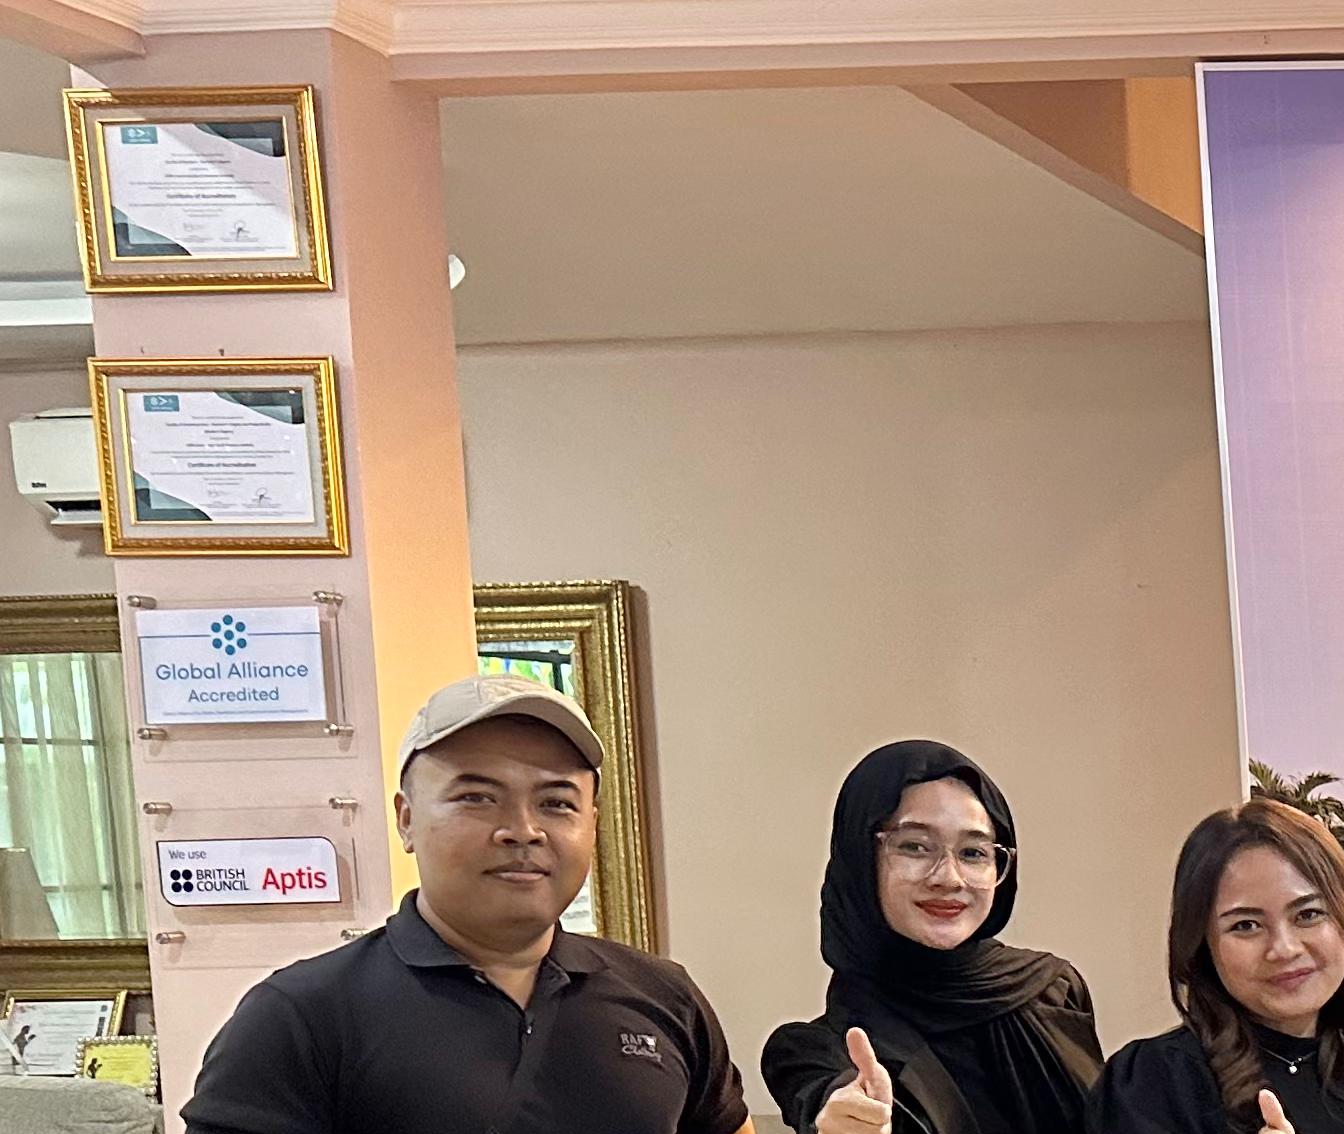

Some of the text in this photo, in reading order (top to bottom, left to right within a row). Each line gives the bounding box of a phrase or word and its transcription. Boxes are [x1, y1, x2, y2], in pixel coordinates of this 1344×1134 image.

[156, 661, 309, 681] Global Alliance
[188, 686, 280, 703] Accredited
[168, 849, 207, 860] We use
[196, 868, 246, 880] BRITISH
[262, 866, 328, 895] Aptis
[196, 879, 250, 892] COUNCIL
